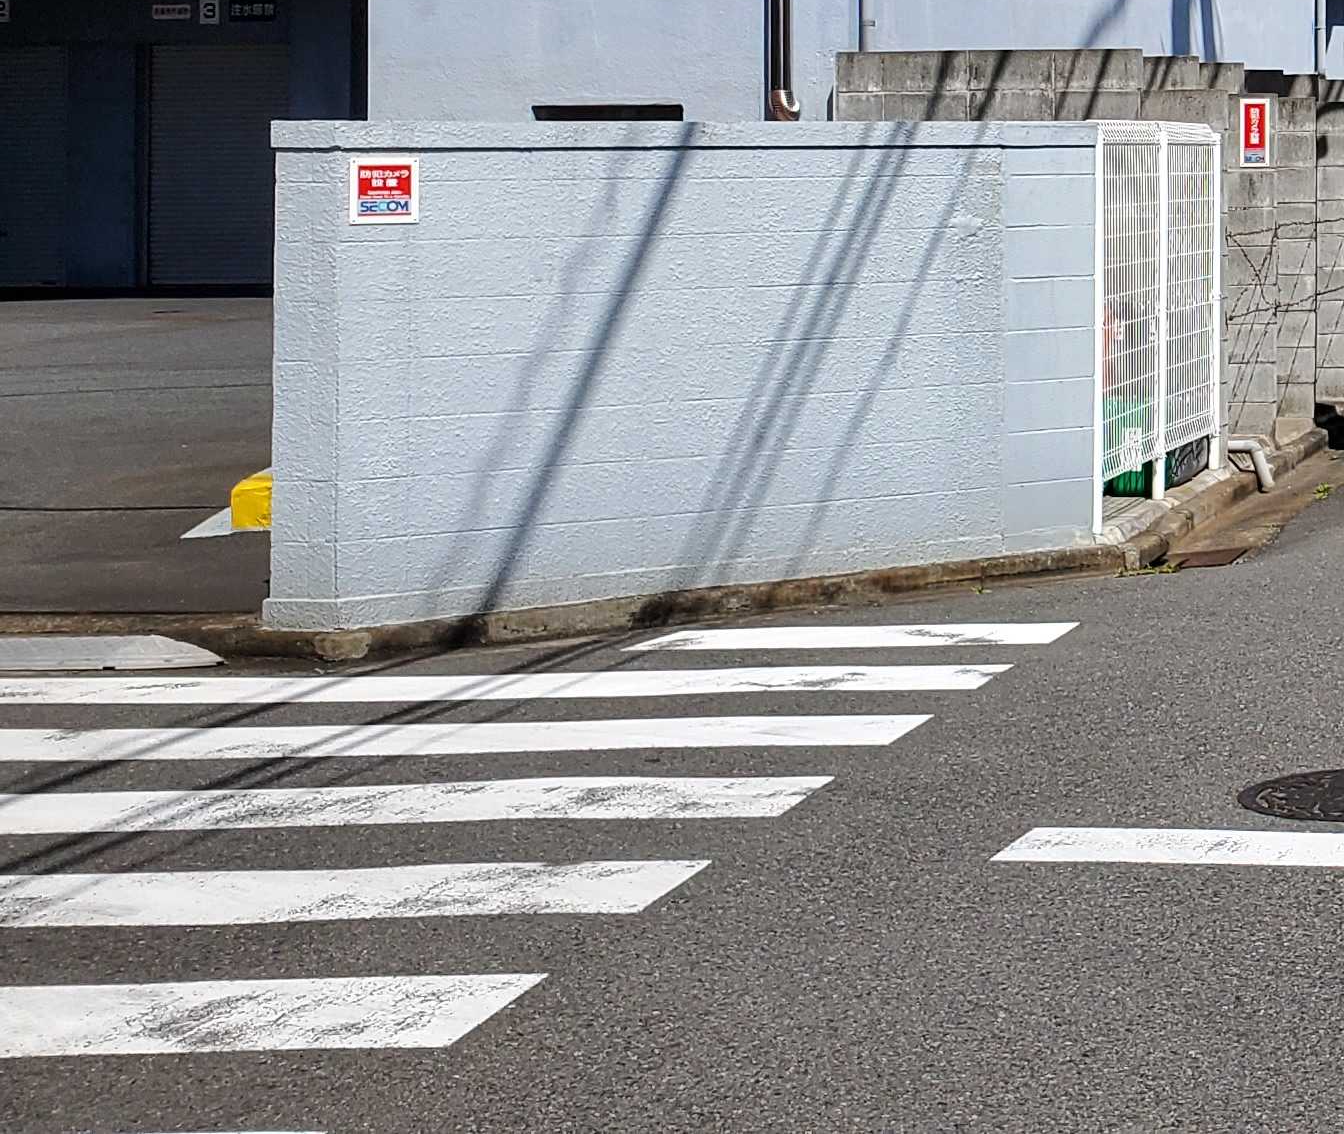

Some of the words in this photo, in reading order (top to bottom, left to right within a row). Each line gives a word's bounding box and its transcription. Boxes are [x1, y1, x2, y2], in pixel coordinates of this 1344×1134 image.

[203, 2, 216, 19] 3
[359, 169, 410, 179] 防犯カメラ
[360, 200, 409, 213] SECOM
